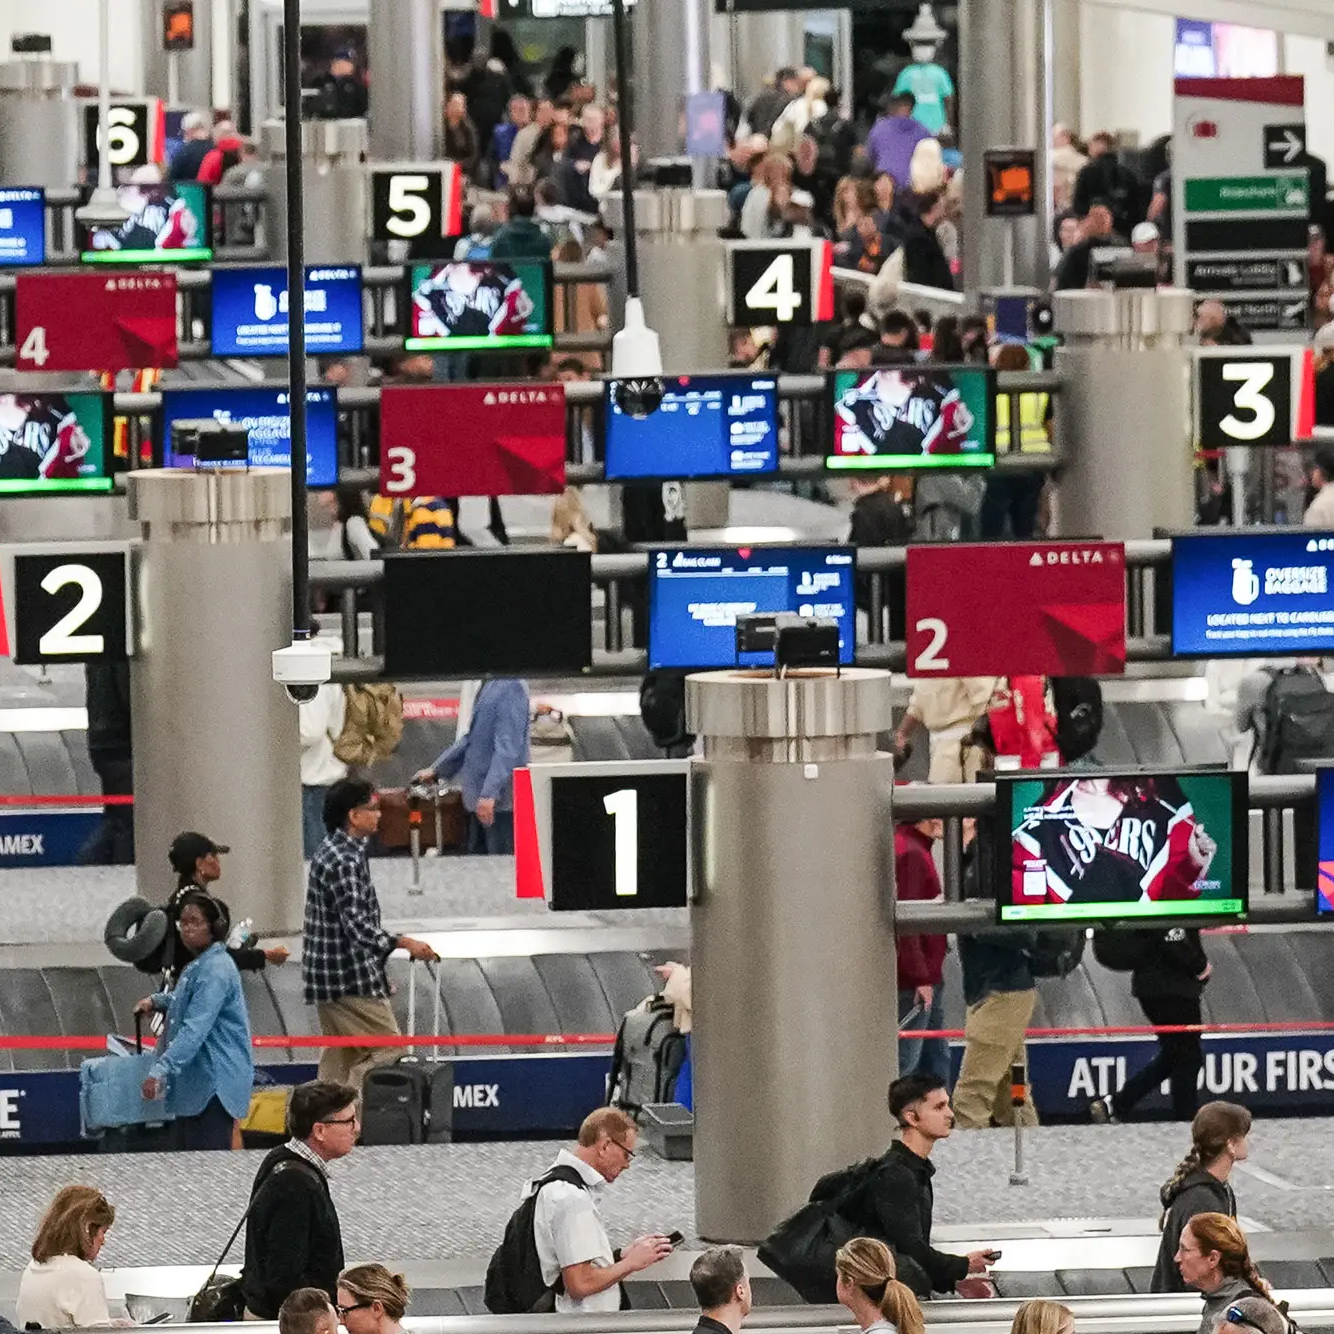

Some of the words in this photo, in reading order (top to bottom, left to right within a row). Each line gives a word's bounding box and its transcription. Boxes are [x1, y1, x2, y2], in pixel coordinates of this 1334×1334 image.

[96, 108, 139, 165] 6
[385, 175, 431, 237] 5
[744, 253, 801, 321] 4
[20, 327, 50, 366] 4
[497, 392, 546, 404] DELTA
[1218, 362, 1275, 441] 3
[385, 446, 417, 492] 3
[656, 552, 668, 568] 2
[1047, 550, 1103, 565] DELTA
[39, 563, 104, 655] 2
[914, 617, 950, 672] 2
[601, 788, 638, 897] 1
